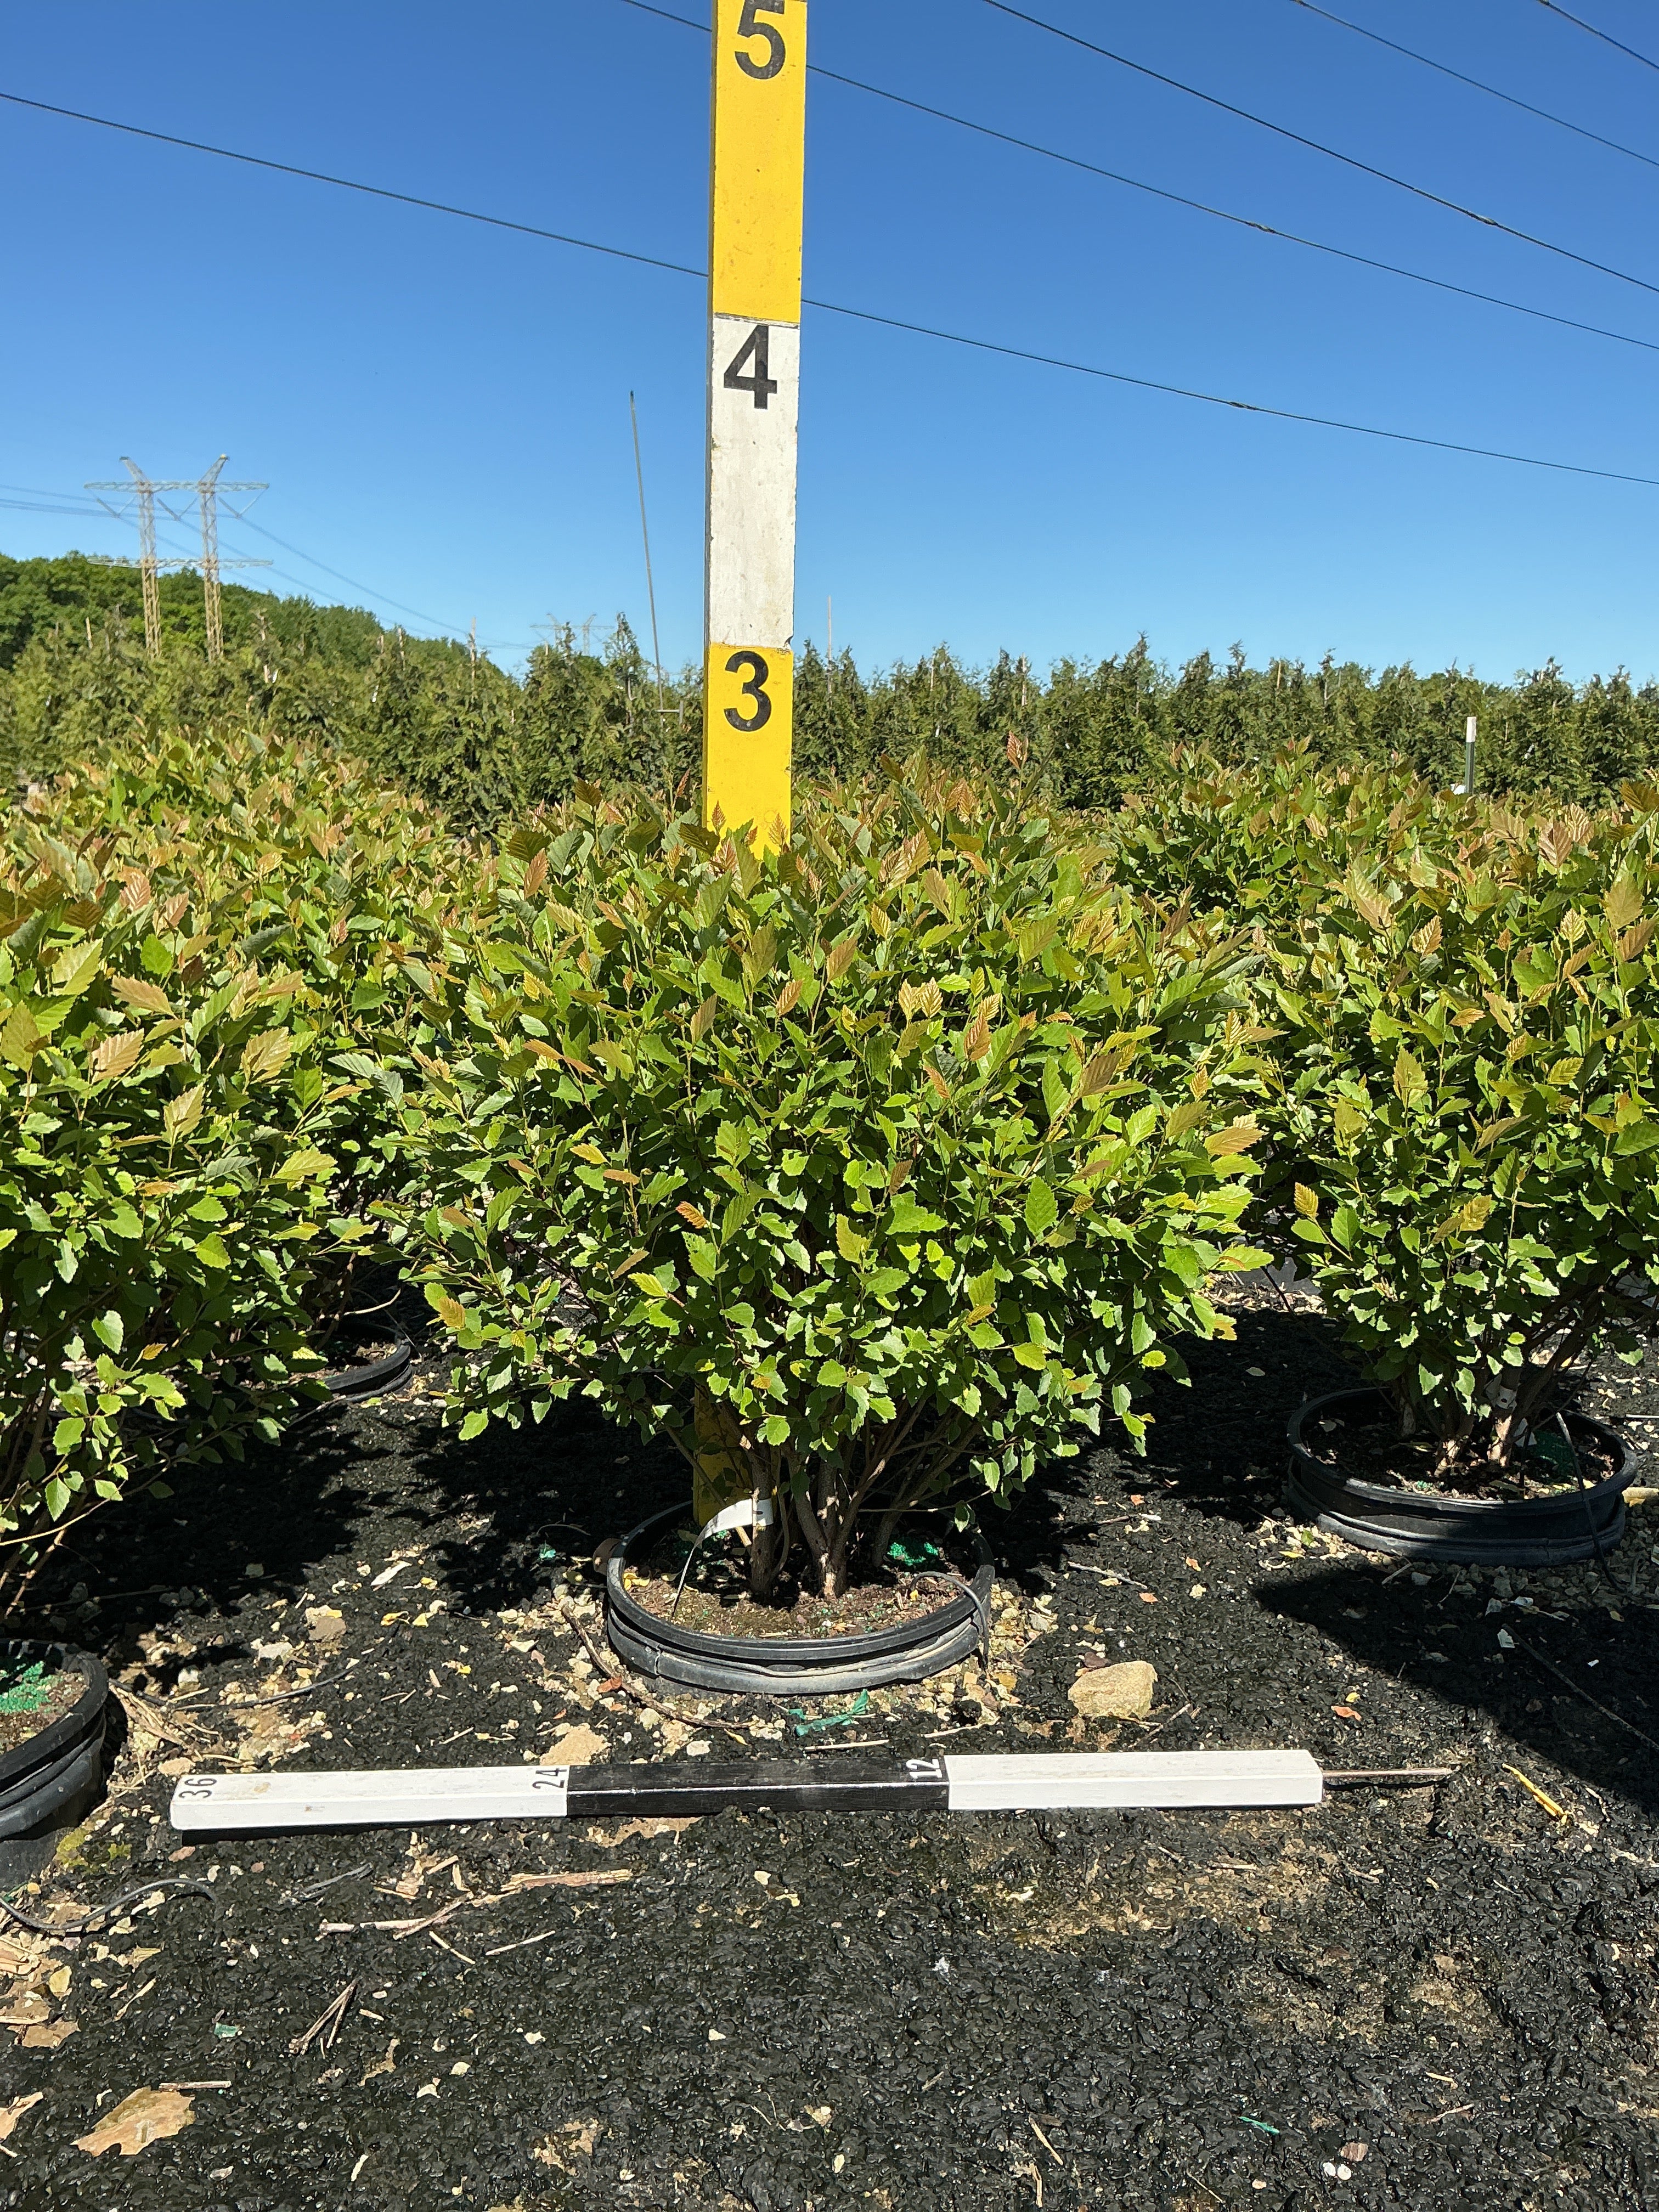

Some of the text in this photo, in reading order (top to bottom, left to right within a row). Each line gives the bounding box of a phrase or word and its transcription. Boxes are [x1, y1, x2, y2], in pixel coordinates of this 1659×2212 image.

[735, 0, 786, 80] 5
[724, 324, 777, 409] 4
[724, 651, 771, 732] 3
[178, 1778, 217, 1798] 36
[532, 1768, 567, 1788] 24
[906, 1759, 943, 1779] 12
